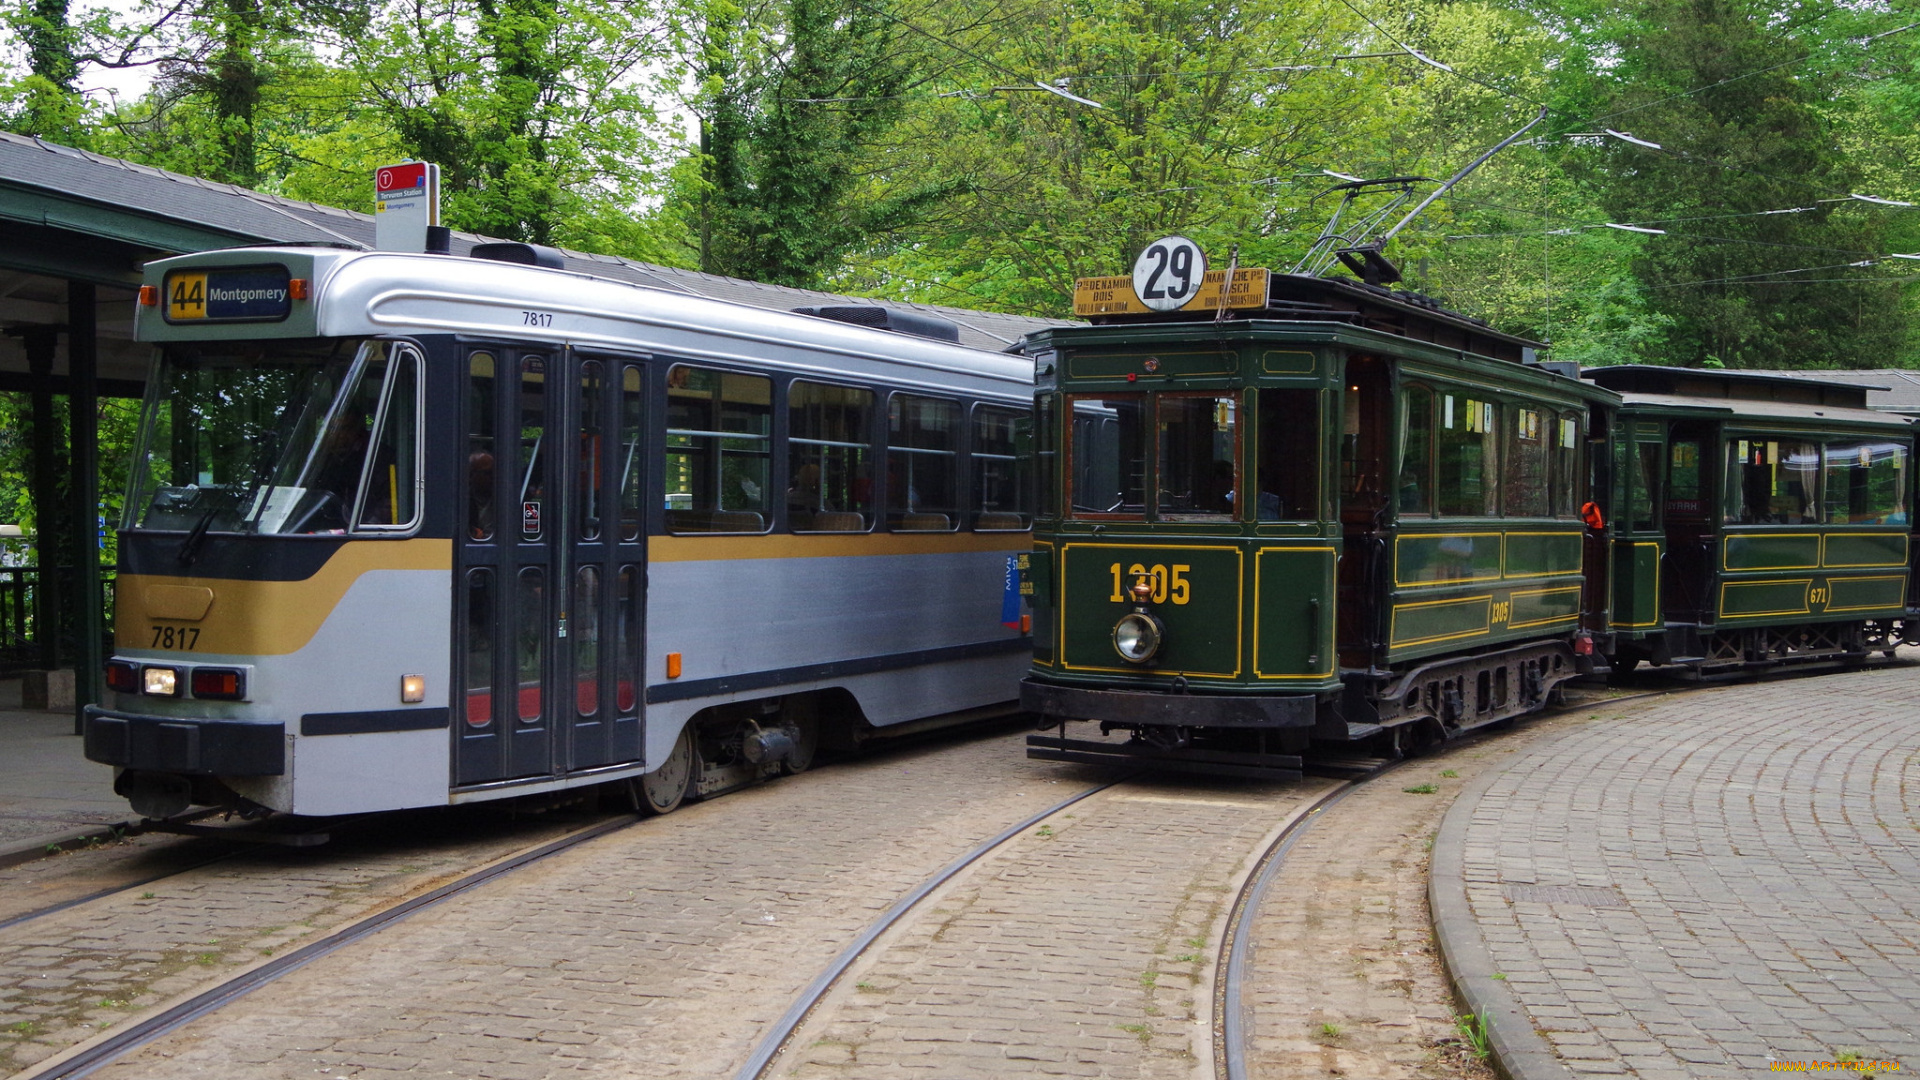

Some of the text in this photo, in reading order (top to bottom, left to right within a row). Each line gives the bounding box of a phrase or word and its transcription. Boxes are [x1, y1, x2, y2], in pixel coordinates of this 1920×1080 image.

[382, 174, 389, 185] T
[404, 189, 422, 197] Station
[1143, 244, 1193, 299] 29
[1101, 278, 1131, 290] NAMUR
[172, 281, 287, 310] 44 Montgomery
[1093, 290, 1113, 302] BOIS
[522, 311, 552, 327] 7817
[1810, 588, 1826, 603] 671
[1492, 601, 1509, 624] 1305
[151, 626, 200, 650] 7817
